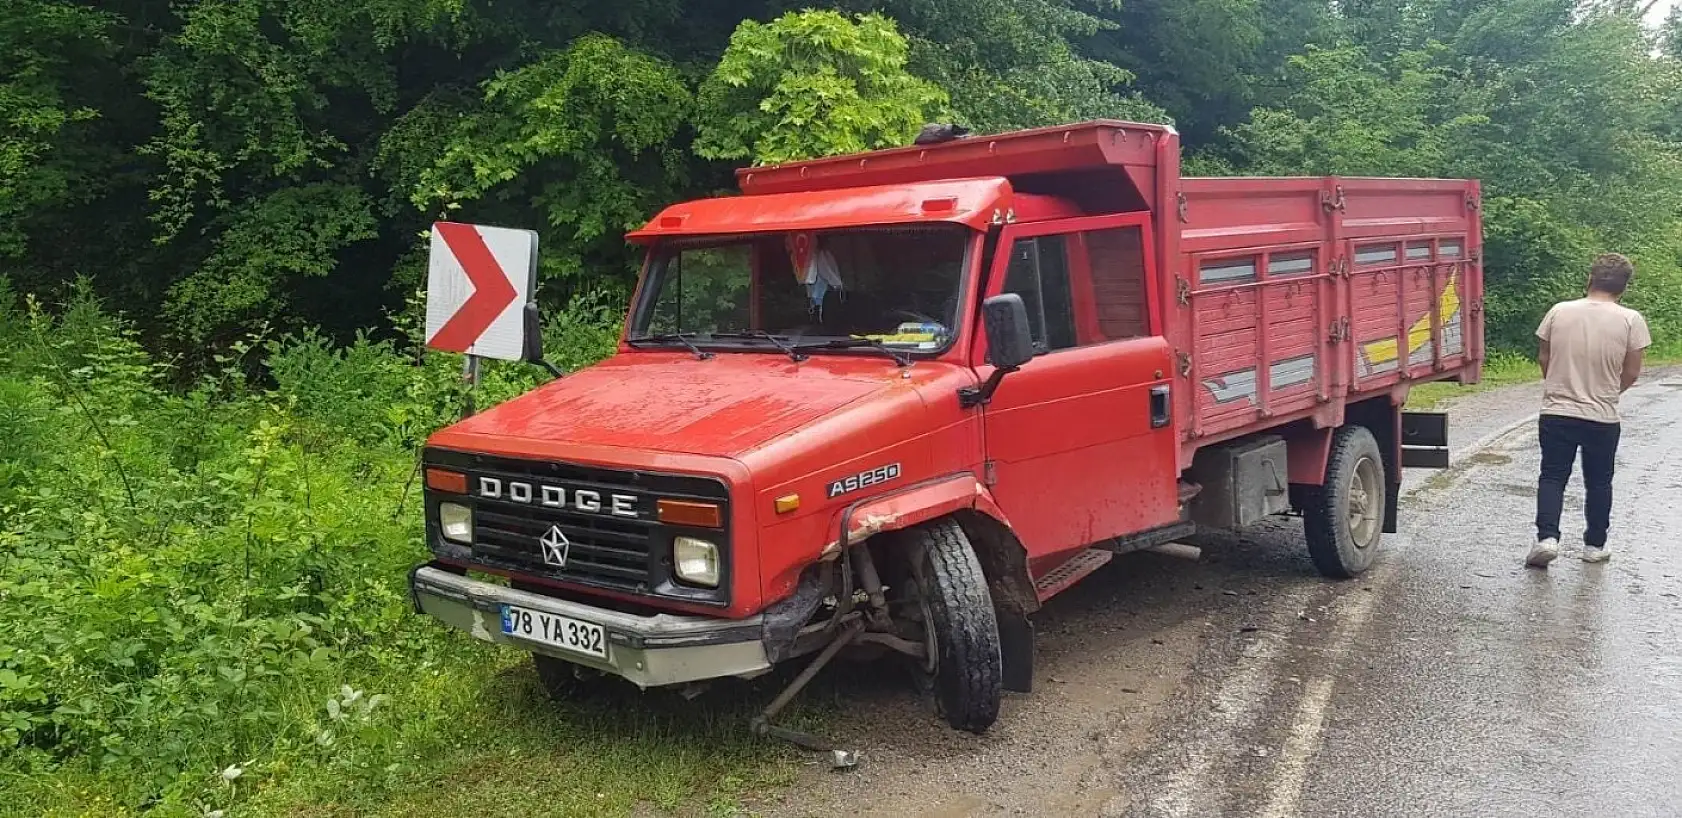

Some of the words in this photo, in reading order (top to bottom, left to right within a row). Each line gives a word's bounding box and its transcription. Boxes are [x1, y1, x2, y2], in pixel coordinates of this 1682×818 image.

[480, 477, 638, 517] DODGE
[830, 463, 900, 497] AS250
[511, 609, 532, 634] 78
[540, 614, 564, 643] YA
[569, 622, 602, 653] 332
